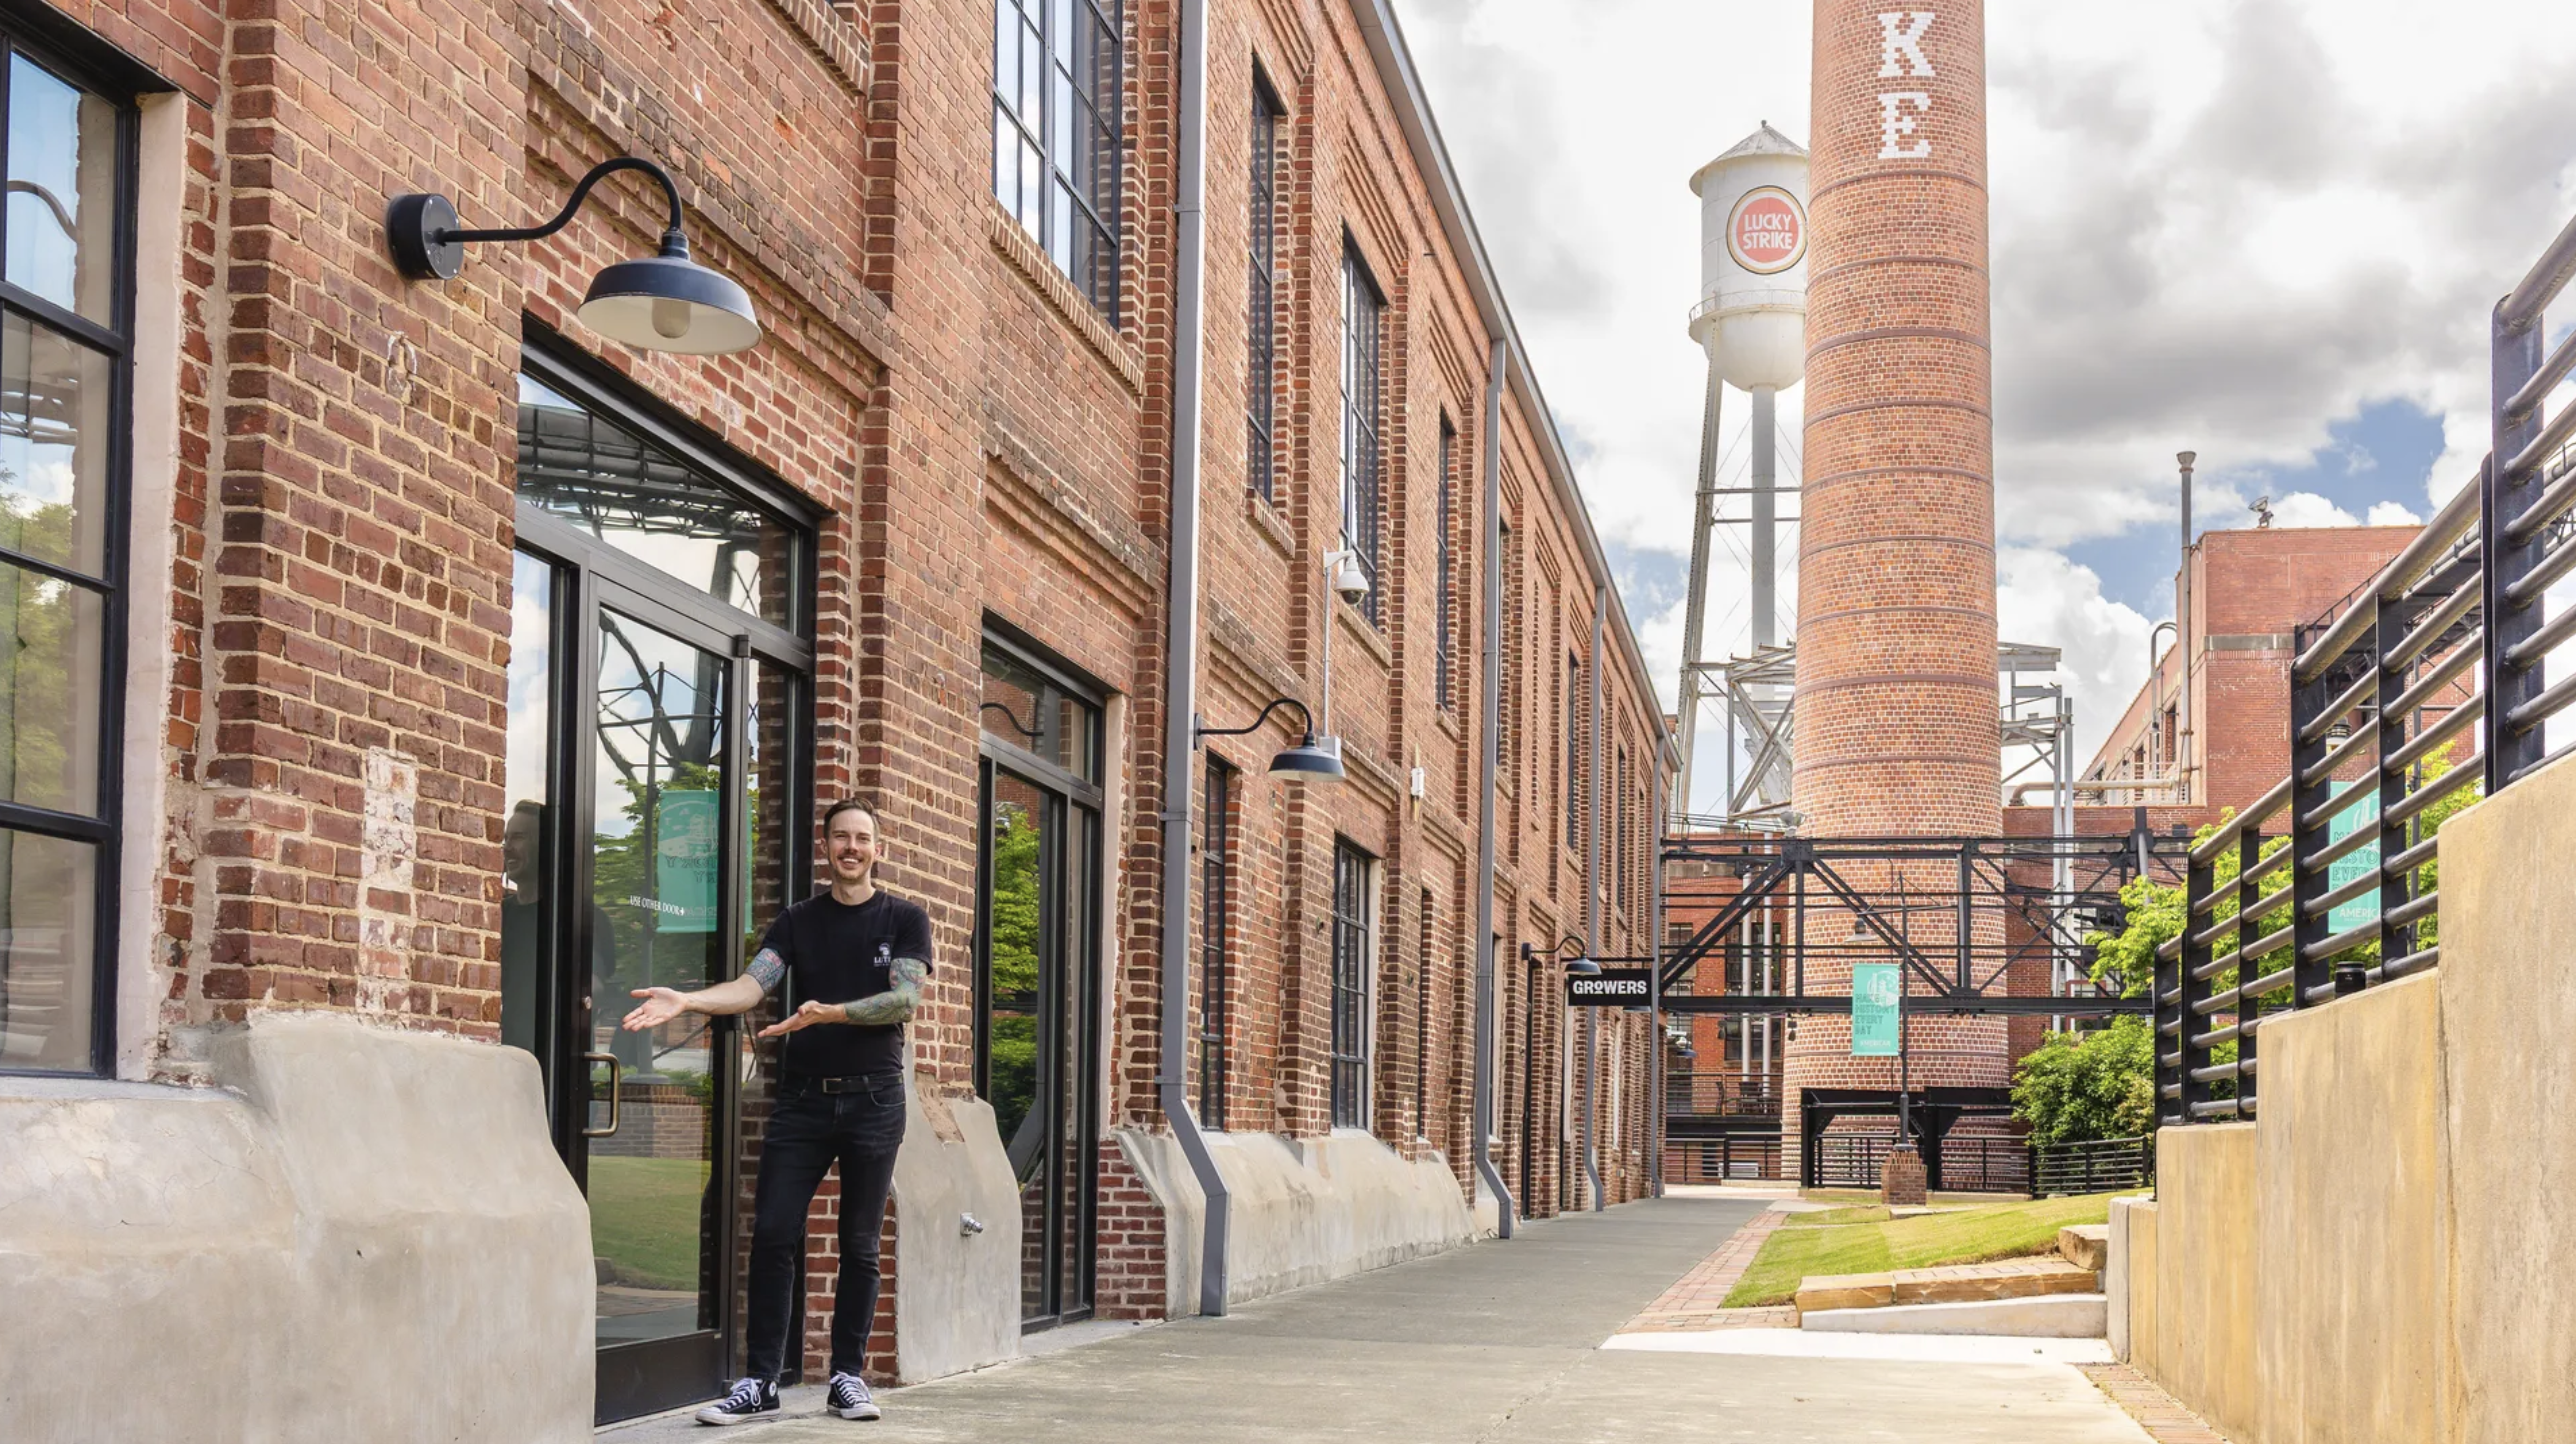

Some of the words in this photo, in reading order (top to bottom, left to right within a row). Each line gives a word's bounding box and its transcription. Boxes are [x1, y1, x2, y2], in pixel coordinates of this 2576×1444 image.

[1744, 213, 1792, 231] LUCKY
[1742, 231, 1794, 250] STRIKE
[630, 895, 641, 906] USE
[641, 897, 661, 911] OTHER
[662, 902, 680, 916] DOOR
[2339, 907, 2378, 918] AMERIC
[1572, 980, 1648, 995] GROWERS
[1855, 1014, 1884, 1025] EVERY
